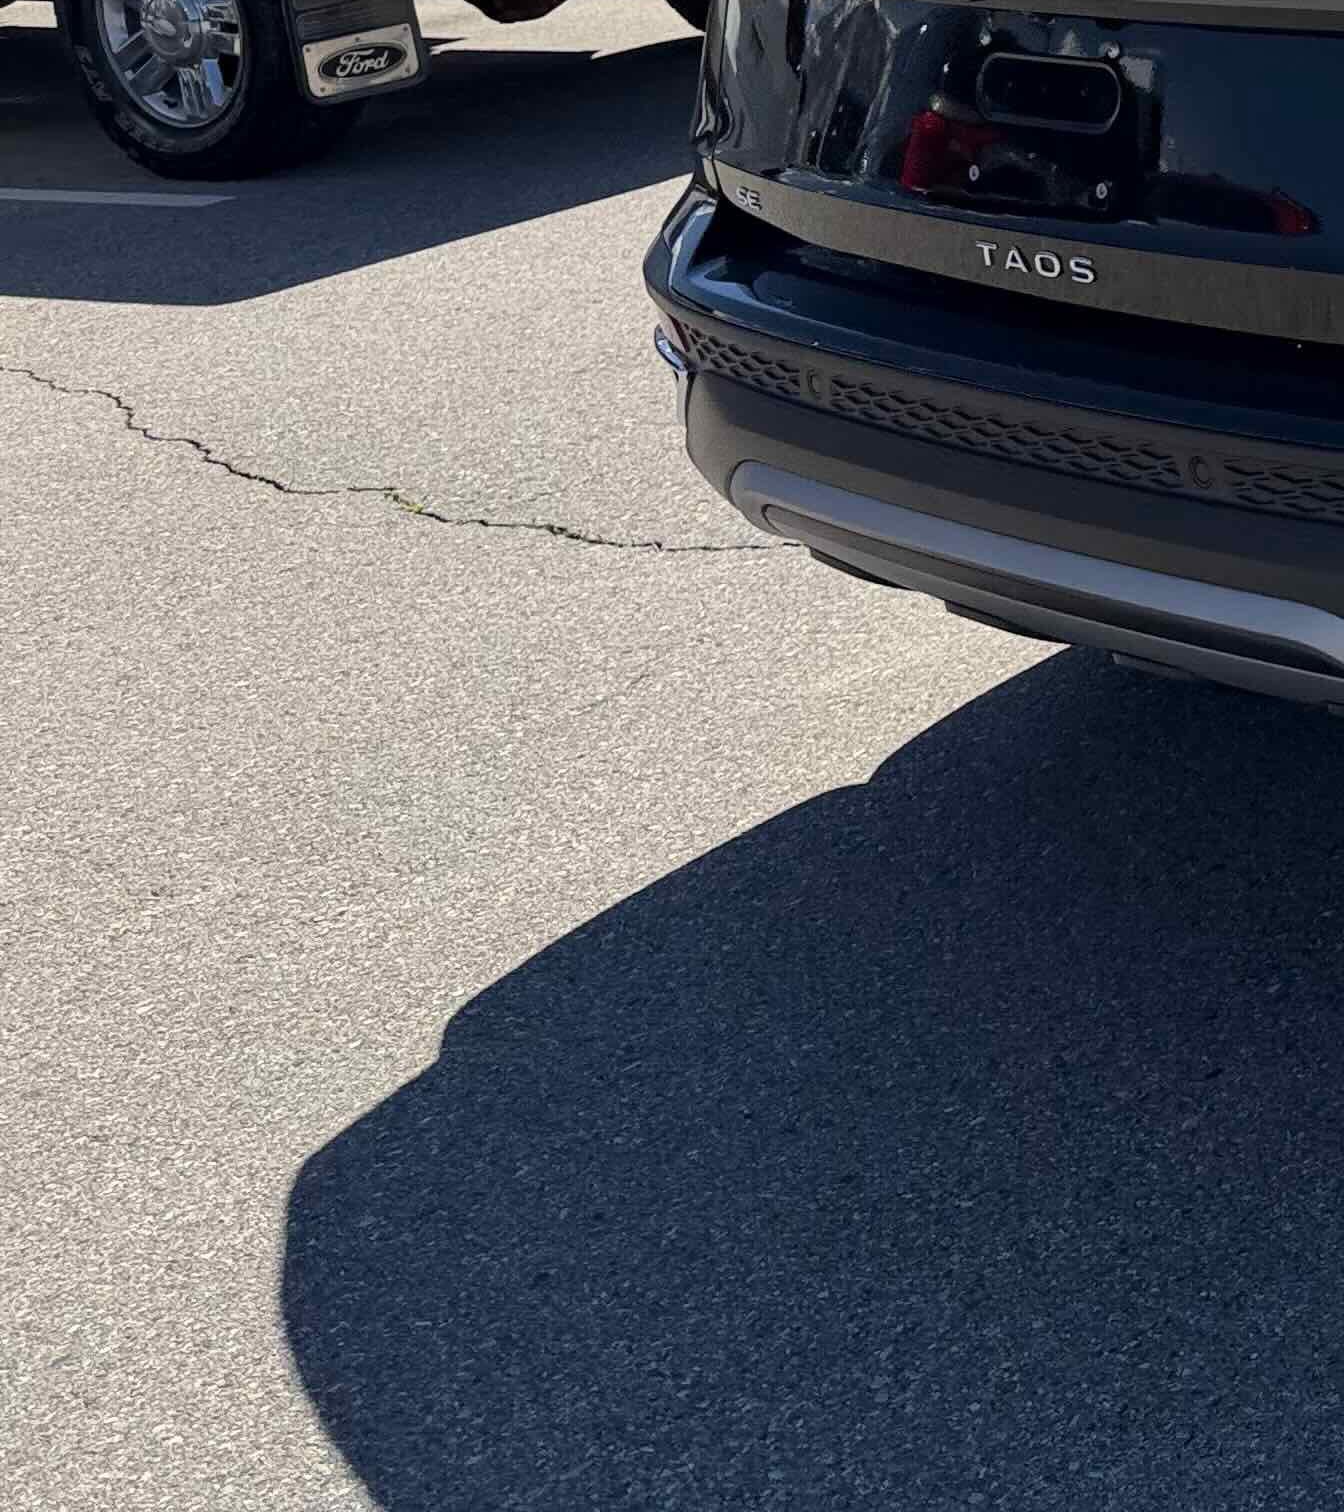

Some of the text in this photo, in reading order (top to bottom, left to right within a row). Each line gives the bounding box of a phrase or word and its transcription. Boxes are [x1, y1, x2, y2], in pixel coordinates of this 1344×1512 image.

[336, 48, 389, 77] Ford
[735, 187, 761, 211] SE
[975, 240, 1096, 284] TAOS
